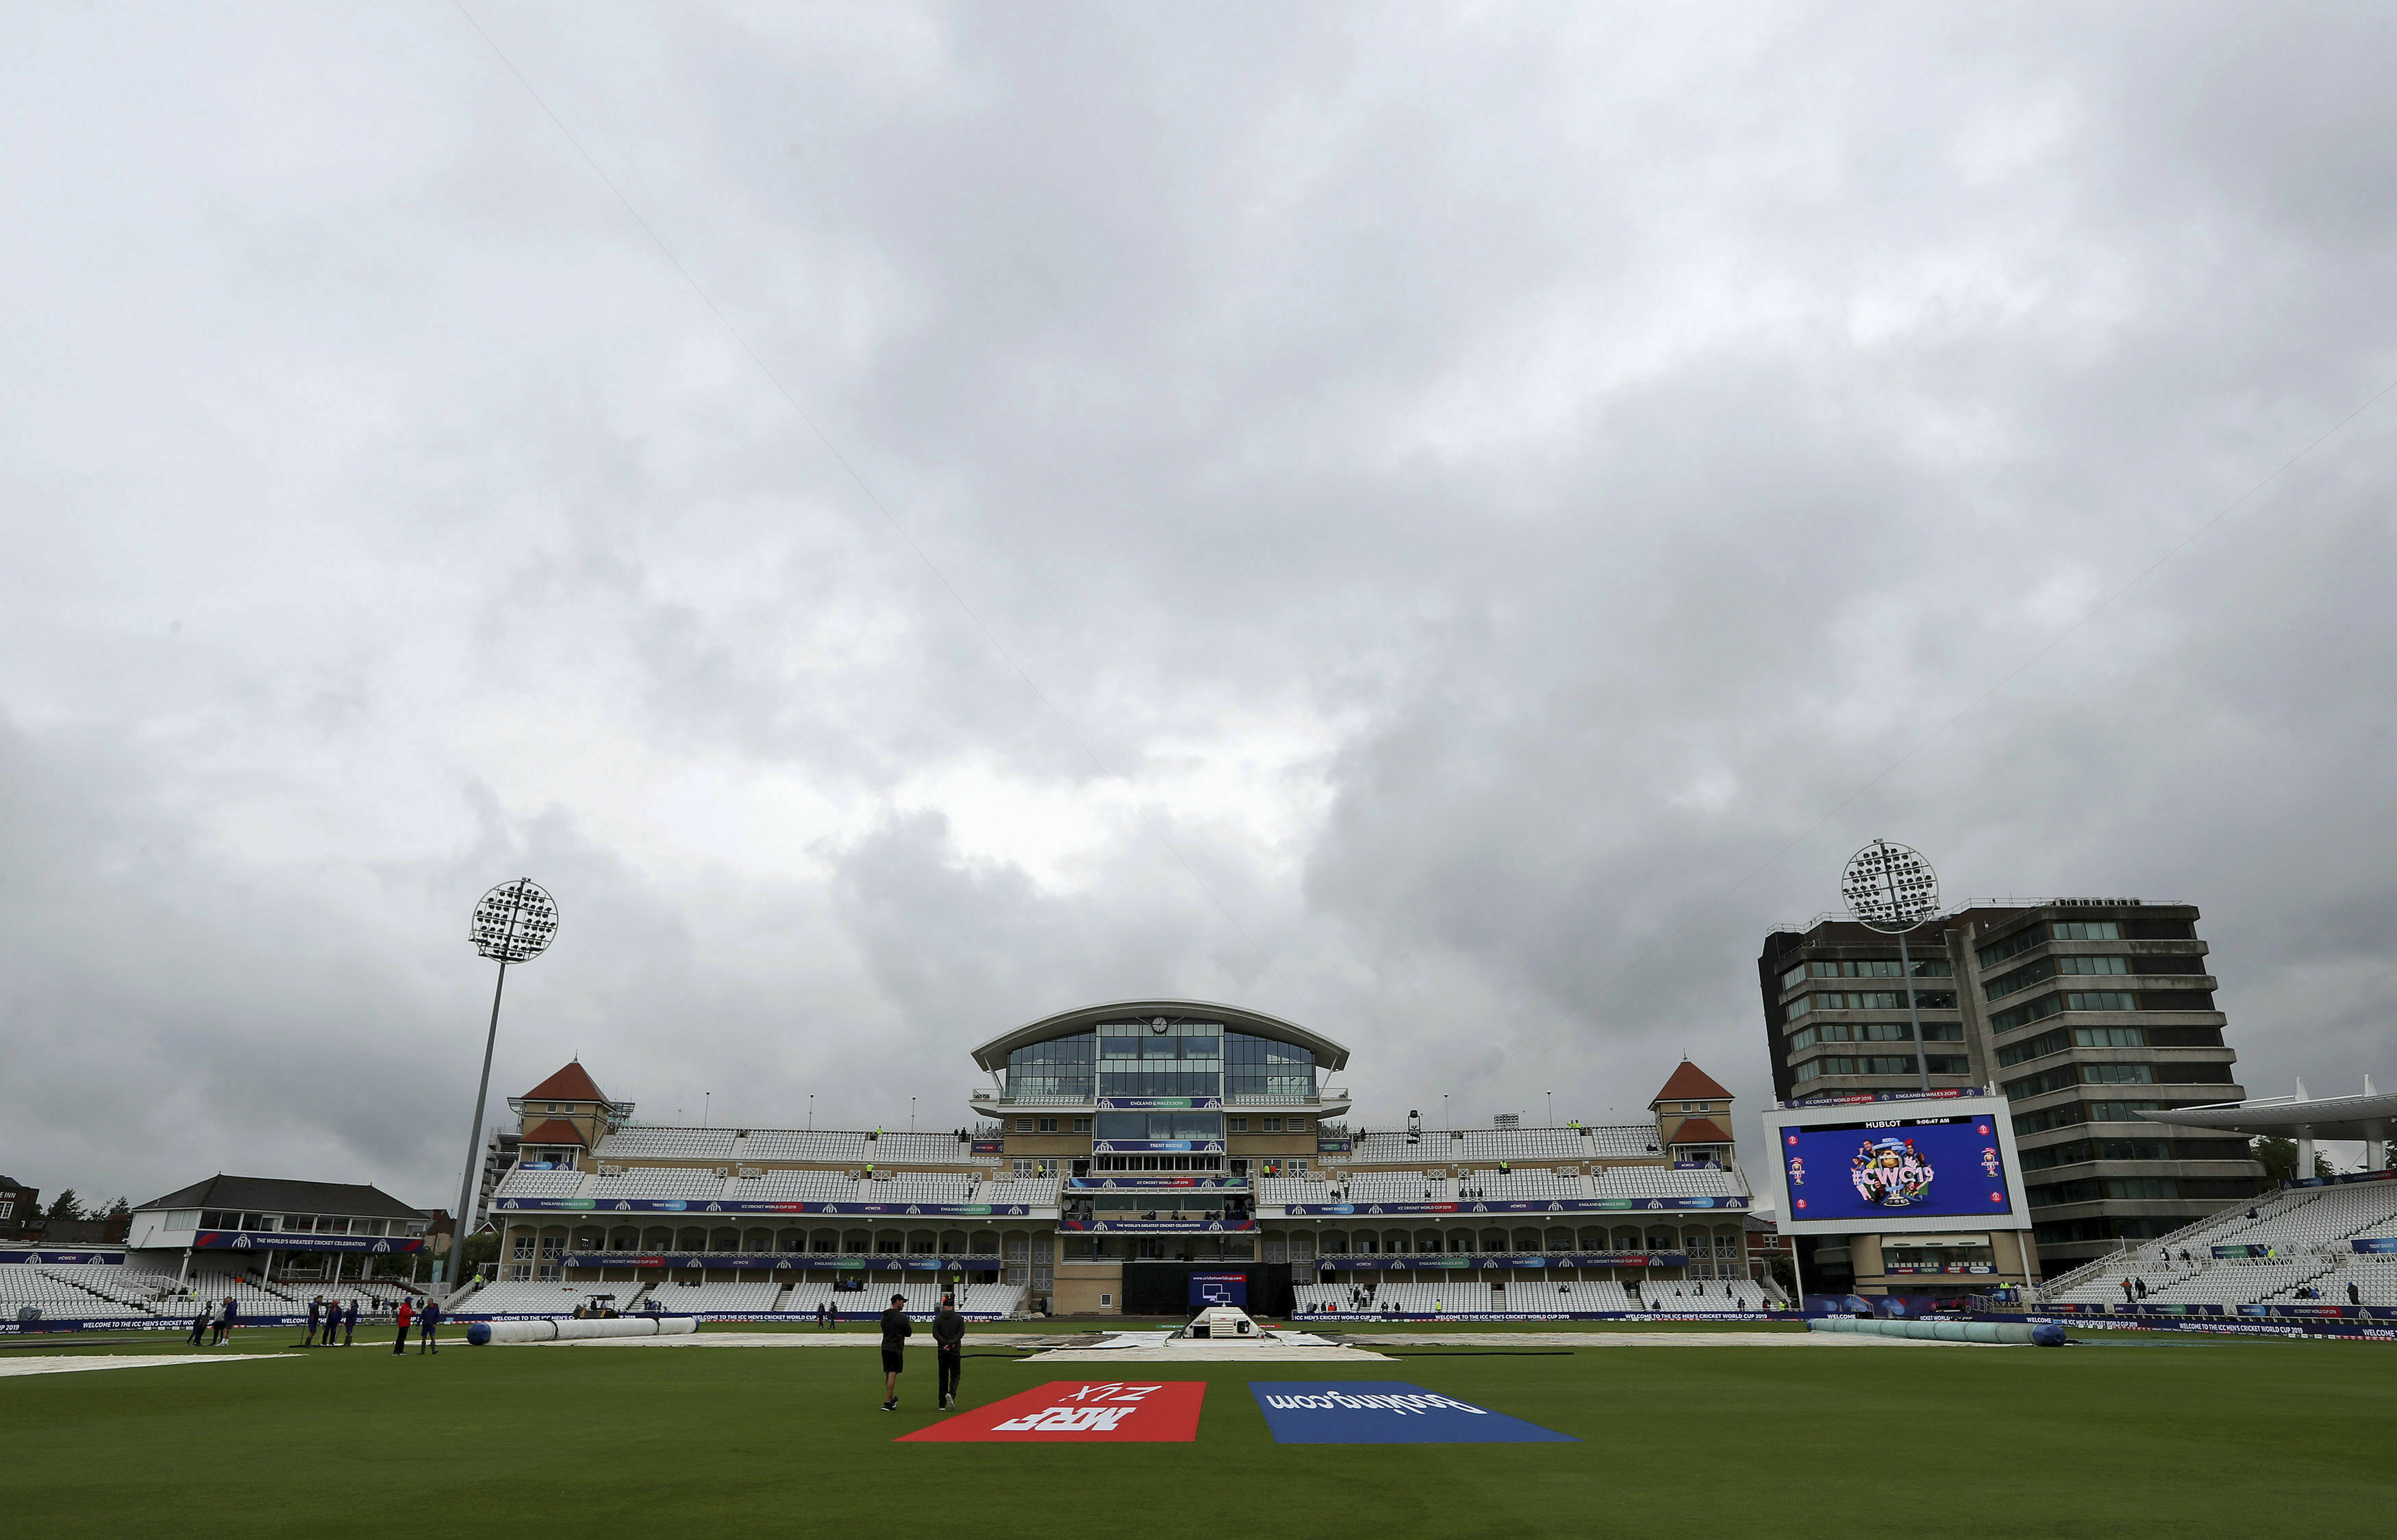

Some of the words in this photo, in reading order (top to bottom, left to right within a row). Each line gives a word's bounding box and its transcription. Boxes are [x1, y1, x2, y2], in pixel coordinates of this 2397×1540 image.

[1866, 1120, 1901, 1128] HUBLOT
[1852, 1167, 1934, 1185] #CWC19
[1266, 1391, 1488, 1415] Booking.com
[991, 1407, 1137, 1431] MRF
